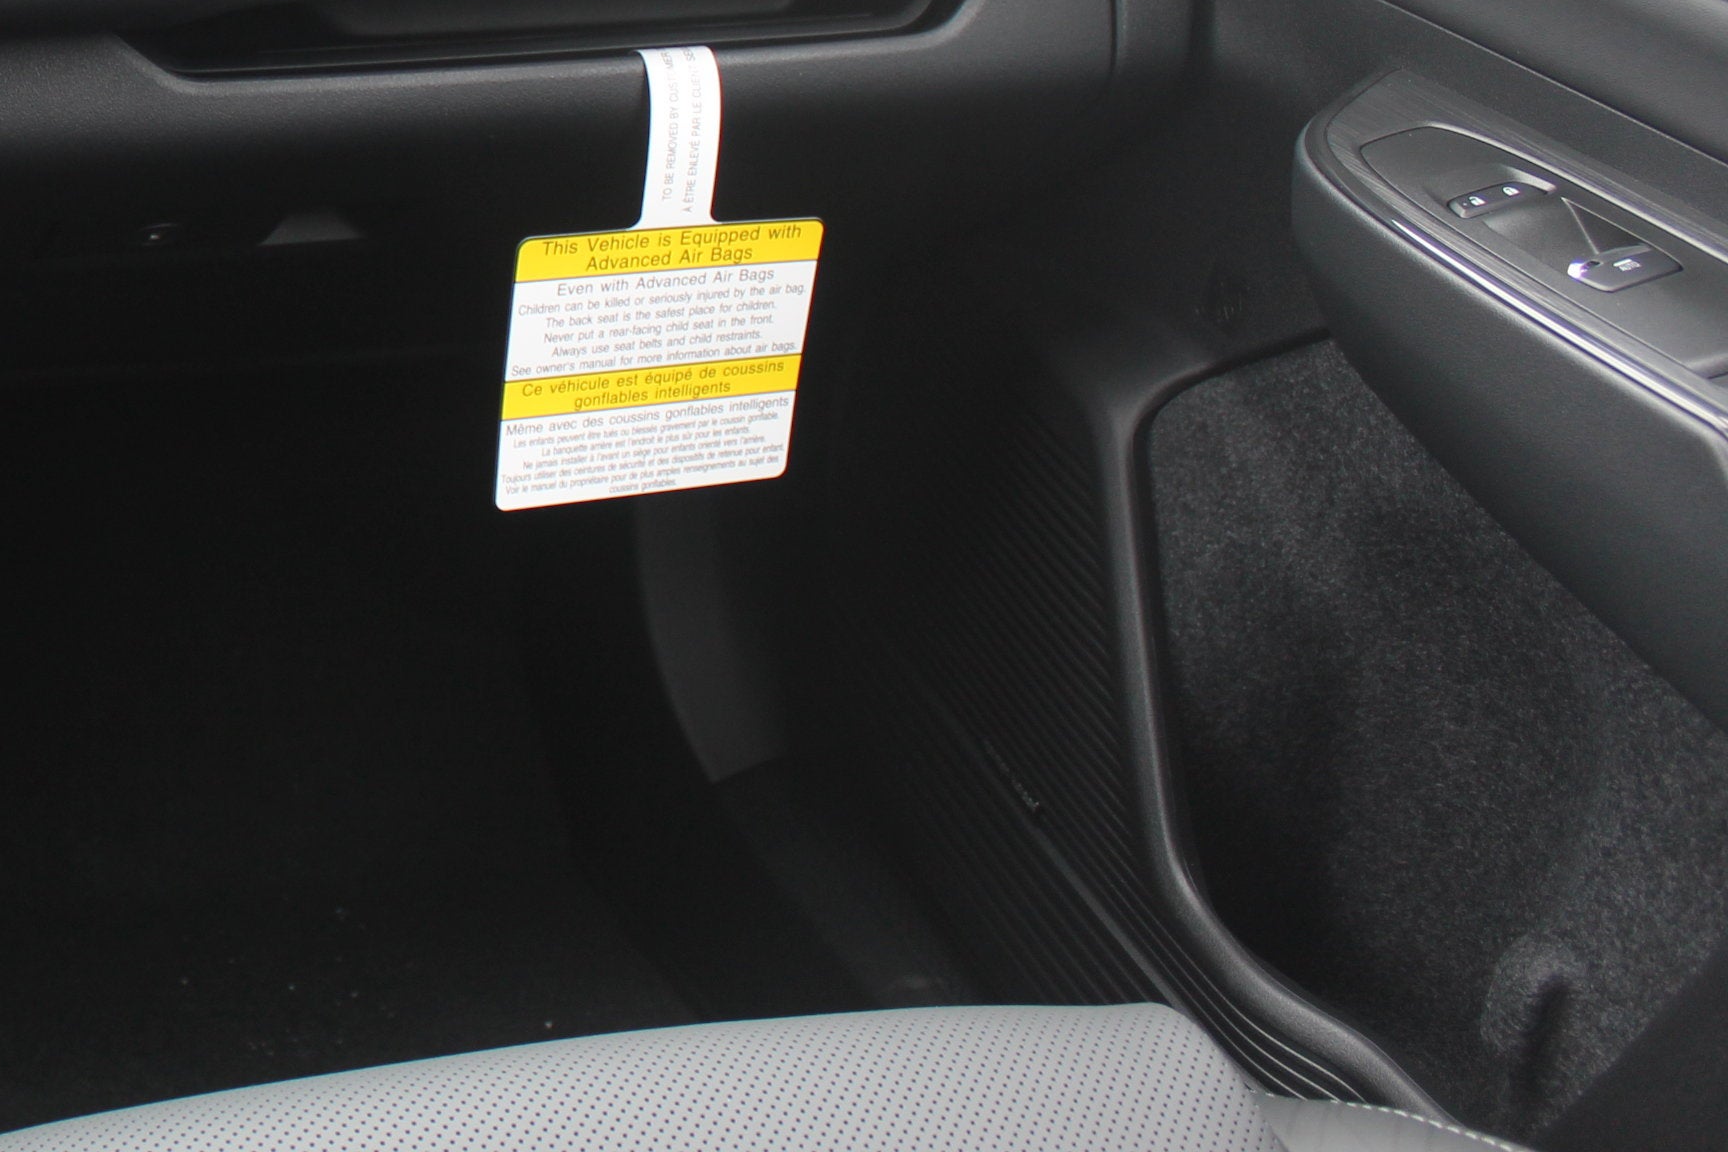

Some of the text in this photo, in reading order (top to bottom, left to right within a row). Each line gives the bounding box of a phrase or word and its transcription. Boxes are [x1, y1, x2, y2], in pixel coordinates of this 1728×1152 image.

[664, 173, 675, 185] BE
[541, 222, 803, 257] This Vehicle is Equipped with
[584, 245, 753, 272] Advanced Air Bags
[556, 267, 775, 297] Even with Advanced Air Bags
[517, 302, 561, 317] Children
[563, 301, 584, 312] can
[603, 296, 631, 308] killed
[648, 290, 693, 305] seriously
[696, 287, 731, 302] injured
[748, 285, 766, 297] the
[768, 285, 783, 296] air
[545, 316, 565, 328] The
[568, 314, 593, 327] back
[596, 312, 619, 324] seat
[634, 309, 652, 321] the
[654, 306, 686, 319] safest
[687, 304, 716, 318] place
[718, 302, 733, 314] for
[543, 332, 575, 344] Never
[576, 329, 595, 342] put
[608, 324, 663, 338] rear-facing
[664, 320, 690, 333] child
[692, 318, 715, 331] seat
[729, 316, 747, 327] the
[550, 345, 588, 357] Always
[590, 343, 610, 354] use
[613, 340, 636, 352] seat
[638, 337, 663, 350] belts
[665, 334, 686, 347] and
[688, 333, 713, 345] child
[510, 364, 532, 377] See
[534, 361, 576, 375] owner's
[578, 355, 617, 370] manual
[619, 354, 634, 366] for
[636, 353, 663, 364] more
[665, 347, 721, 361] information
[723, 344, 753, 357] about
[754, 343, 769, 354] air
[521, 360, 785, 398] Ce véhicule est équipé de coussins
[573, 380, 732, 412] gonflables intelligents
[505, 395, 790, 436] Même avec des coussins gonflables intelligents
